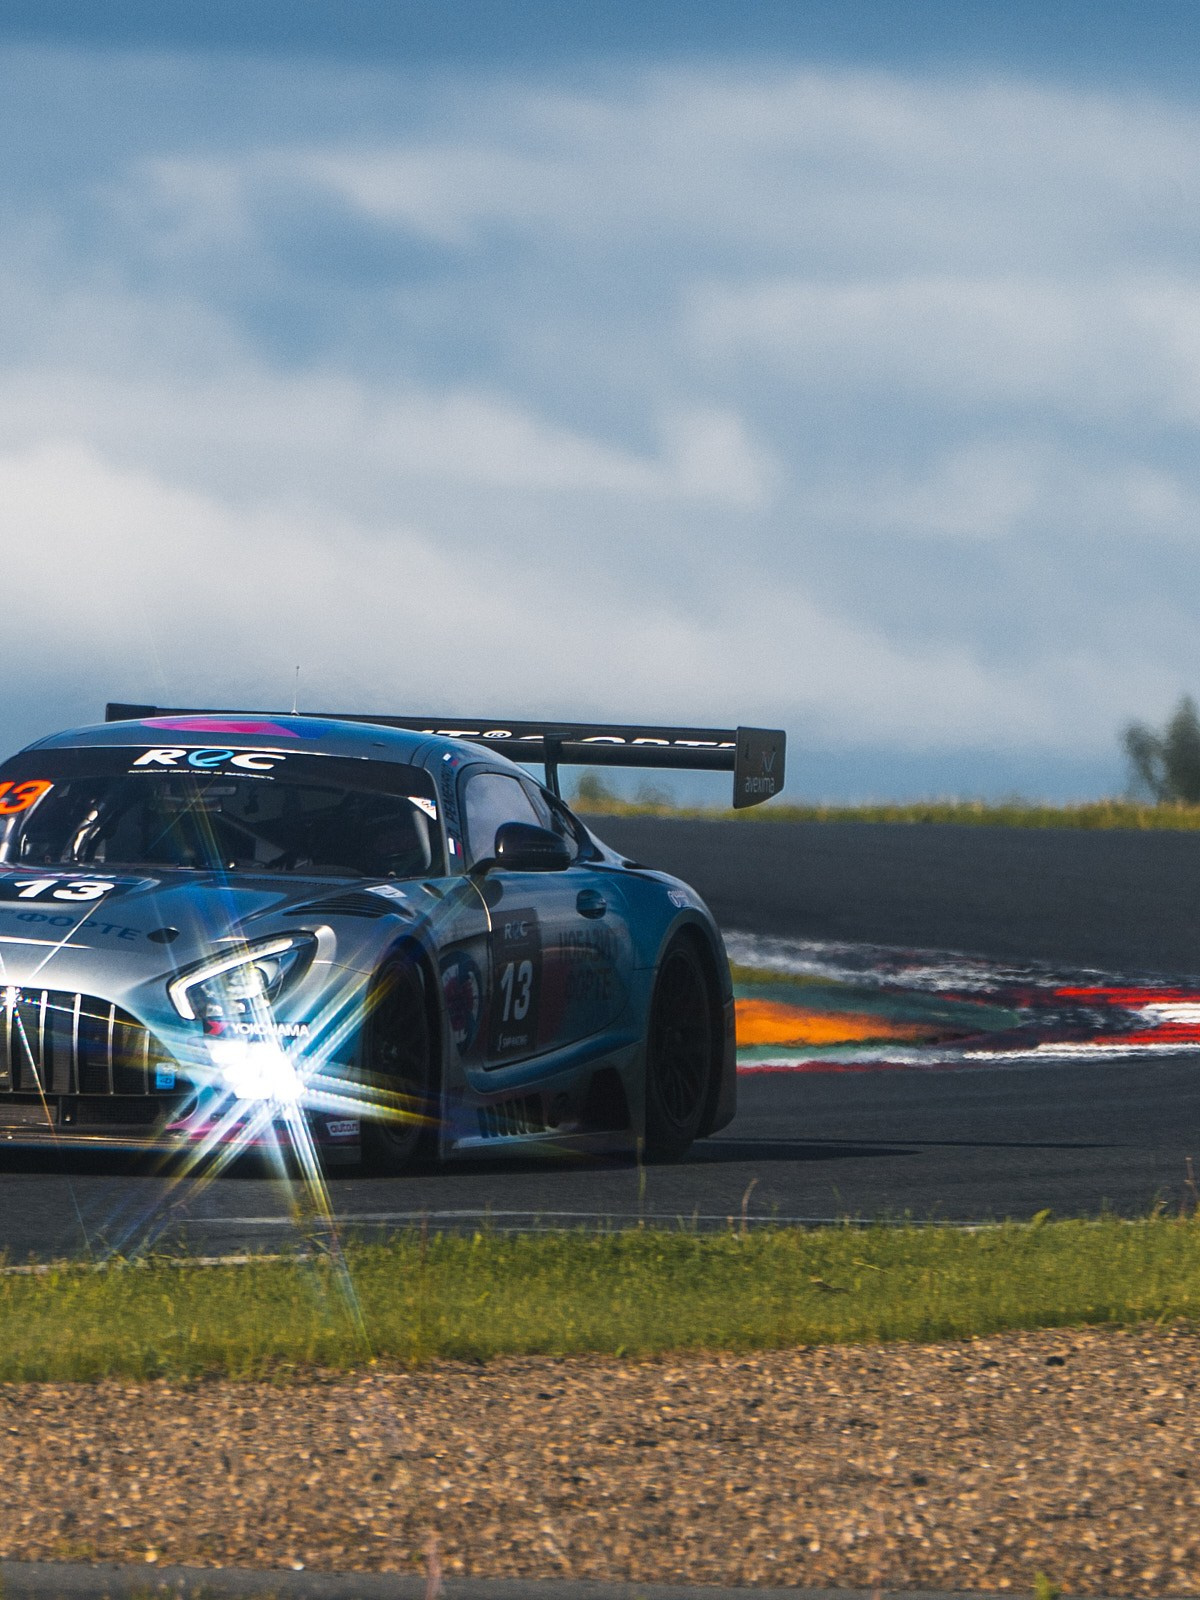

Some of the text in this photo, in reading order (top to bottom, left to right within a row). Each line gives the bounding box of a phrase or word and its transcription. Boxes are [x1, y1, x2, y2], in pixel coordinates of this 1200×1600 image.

[745, 772, 776, 793] avexima
[14, 879, 116, 901] 13
[500, 960, 534, 1022] 13
